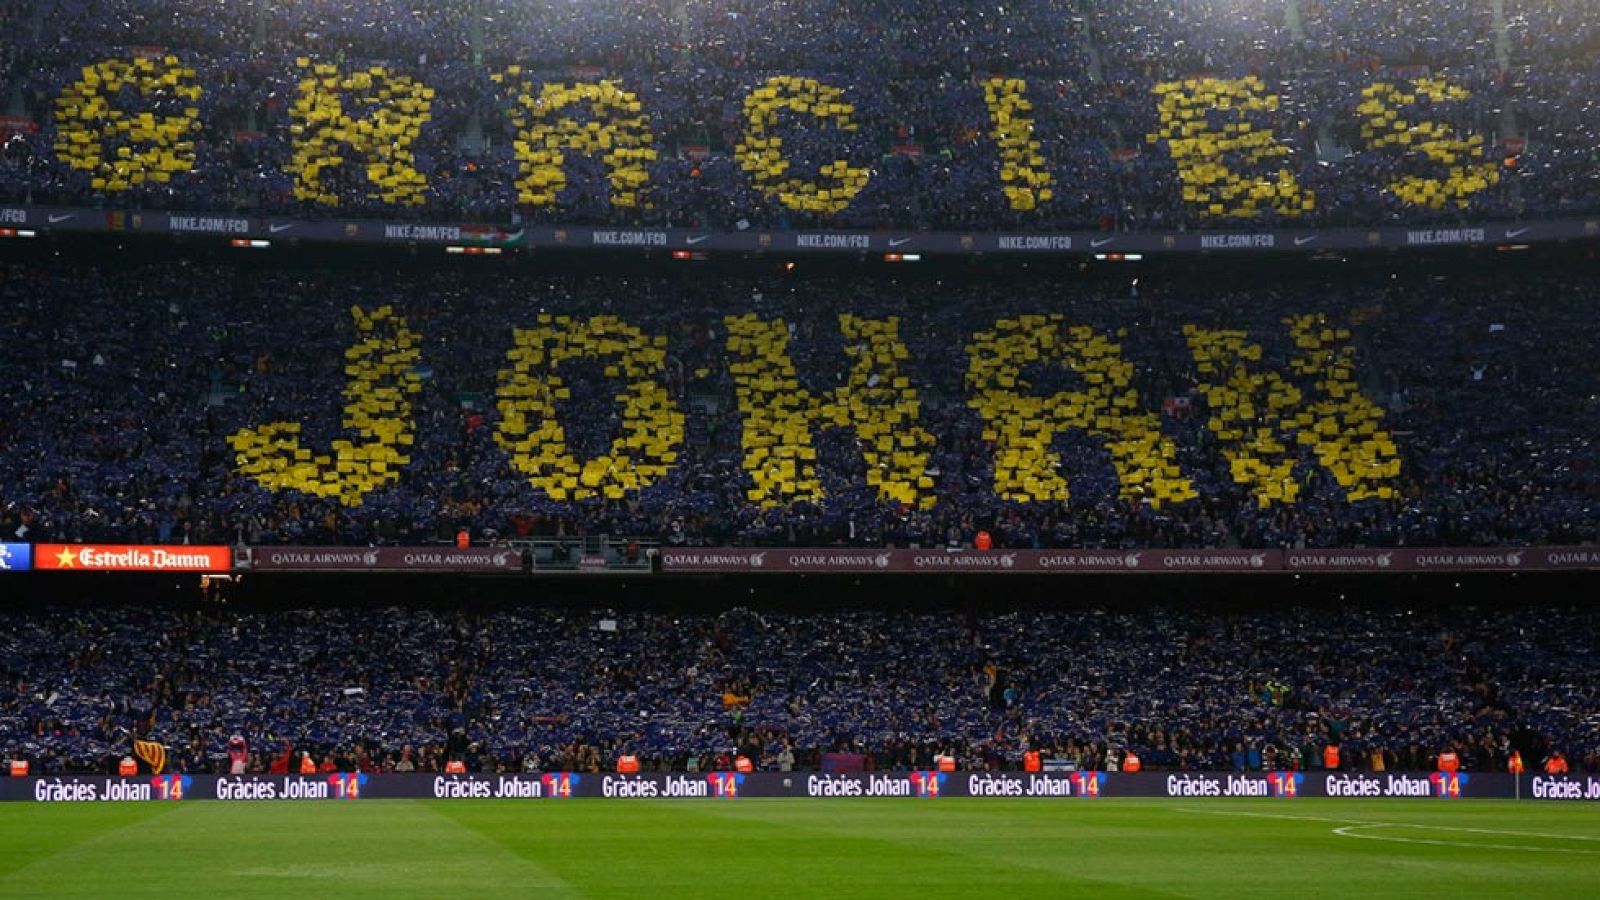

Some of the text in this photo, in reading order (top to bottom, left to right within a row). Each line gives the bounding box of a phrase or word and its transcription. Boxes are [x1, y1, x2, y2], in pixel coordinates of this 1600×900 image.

[169, 215, 249, 233] NIKE.COM/FCB
[384, 224, 460, 240] NIKE.COM/FCB
[593, 231, 667, 245] NIKE.COM/FCB
[1407, 229, 1485, 245] NIKE.COM/FCB
[797, 234, 870, 248] NIKE.COM/FCB
[999, 235, 1072, 249] NIKE.COM/FCB
[1201, 234, 1274, 248] NIKE.COM/FCB
[79, 547, 210, 568] Estrella Damm
[272, 554, 361, 564] QATAR AIRWAYS
[405, 554, 491, 564] QATAR AIRWAYS
[664, 555, 748, 565] QATAR AIRWAYS
[789, 556, 873, 565] QATAR AIRWAYS
[914, 556, 998, 566] QATAR AIRWAYS
[1039, 556, 1124, 566] QATAR AIRWAYS
[1164, 556, 1249, 566] QATAR AIRWAYS
[1290, 556, 1375, 566] QATAR AIRWAYS
[1417, 555, 1503, 565] QATAR AIRWAYS
[1548, 552, 1587, 564] QATAR
[36, 778, 183, 800] Gràcies Johan 14
[217, 776, 359, 798] Gràcies Johan 14
[434, 776, 571, 797] Gràcies Johan 14
[603, 775, 736, 797] Gràcies Johan 14
[808, 774, 939, 796] Gràcies Johan 14
[970, 774, 1099, 796] Gràcies Johan 14
[1167, 774, 1296, 796] Gràcies Johan 14
[1327, 774, 1460, 796] Gràcies Johan 14
[1533, 776, 1582, 798] Gràcies
